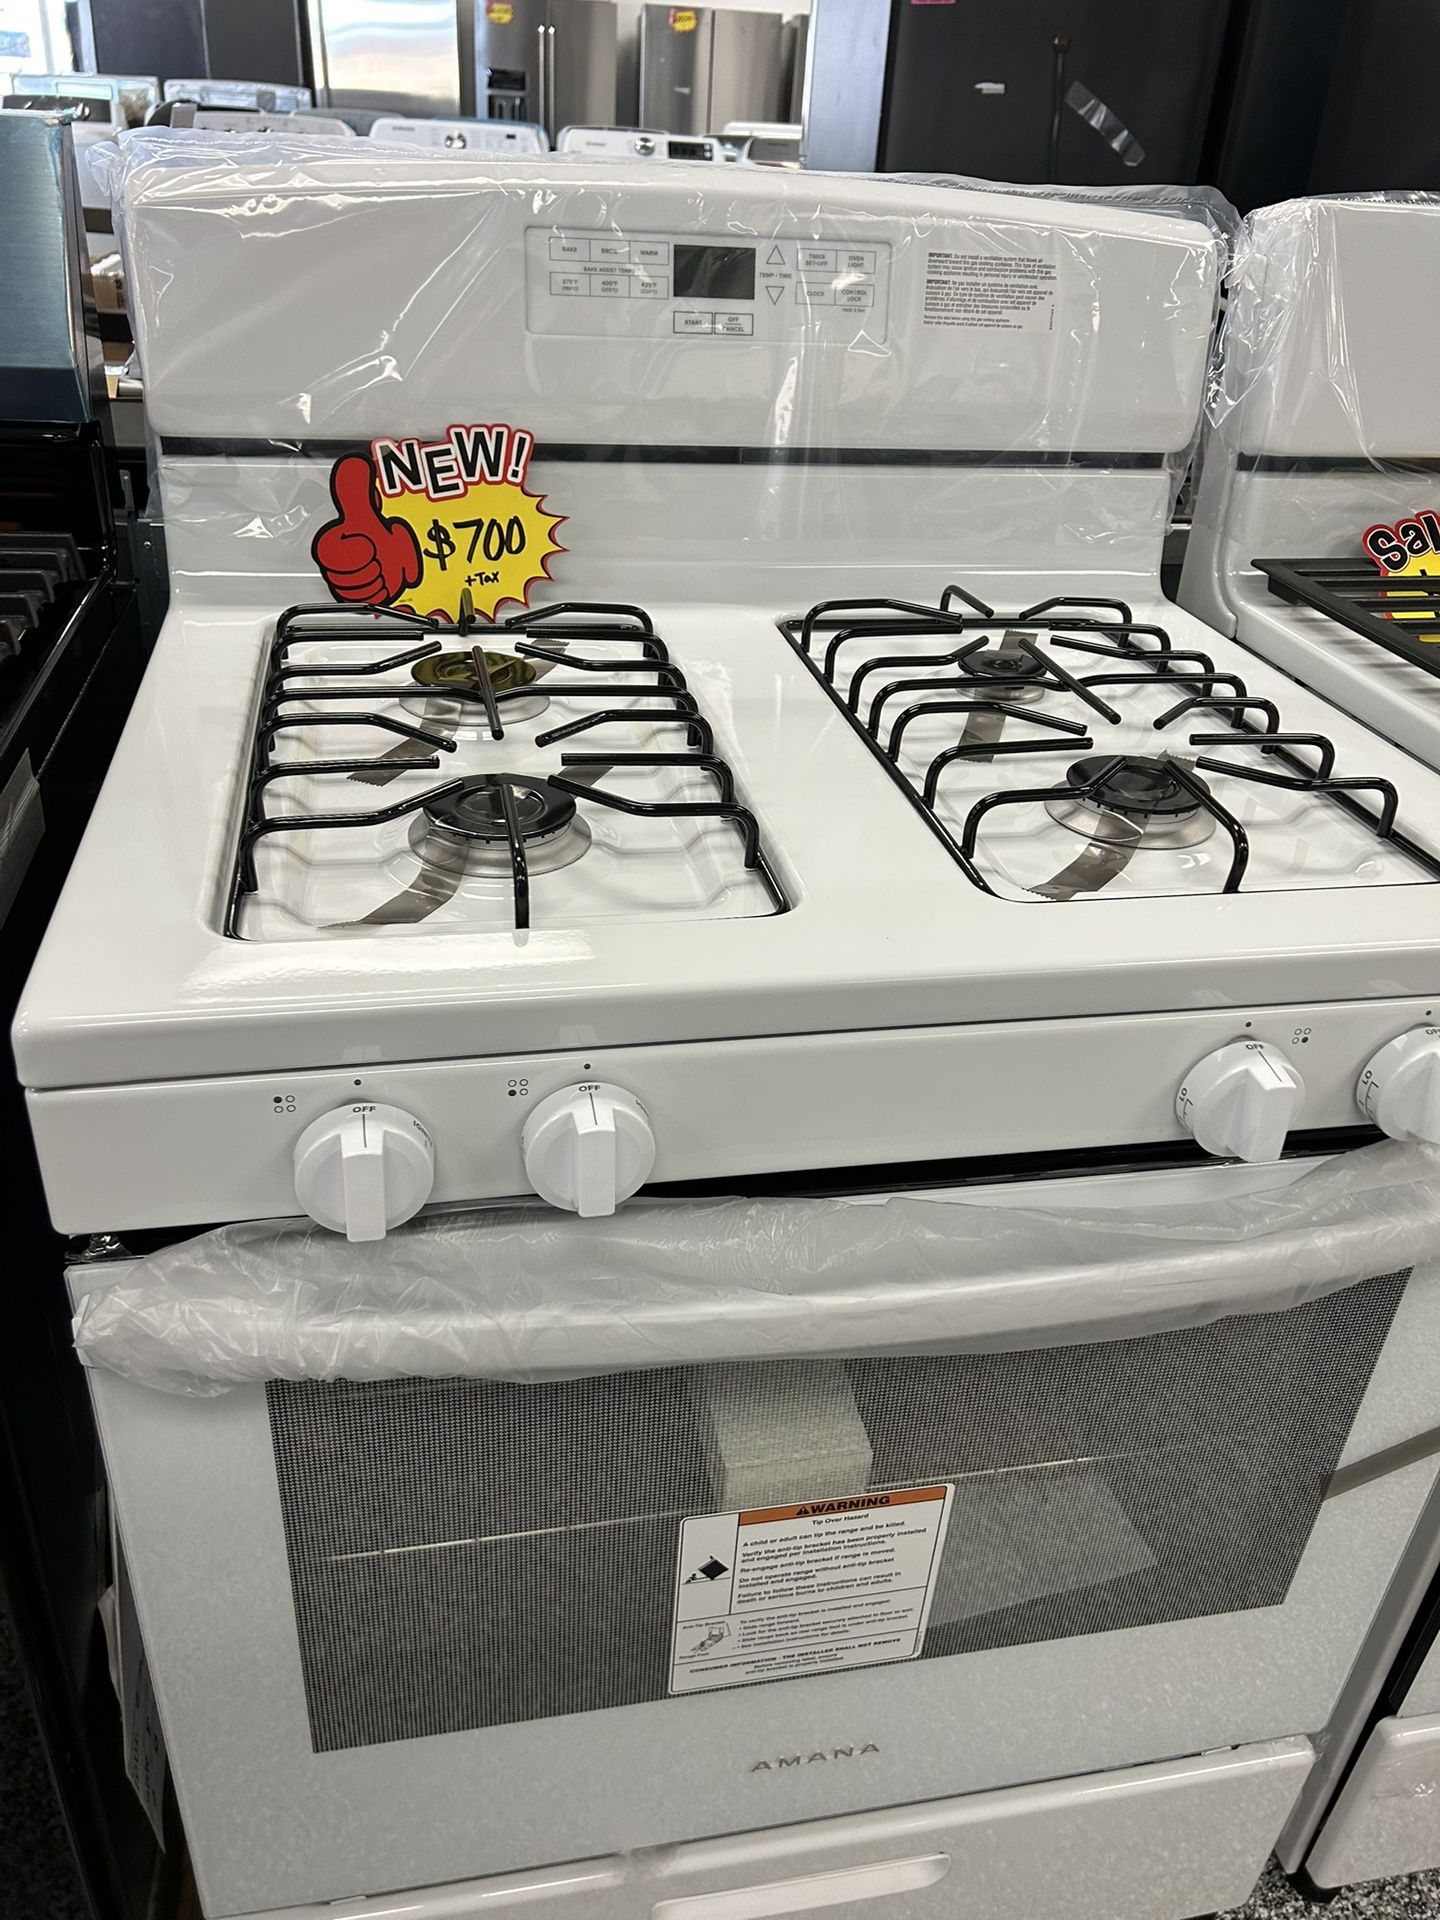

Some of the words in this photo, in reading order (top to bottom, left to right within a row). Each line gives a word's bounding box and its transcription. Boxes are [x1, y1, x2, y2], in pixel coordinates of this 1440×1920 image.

[378, 430, 528, 495] NEW!
[423, 515, 526, 571] $700
[1367, 514, 1440, 571] Sal
[465, 571, 500, 587] +Tax
[810, 1496, 890, 1514] WARNING
[751, 1743, 880, 1772] AMANA
